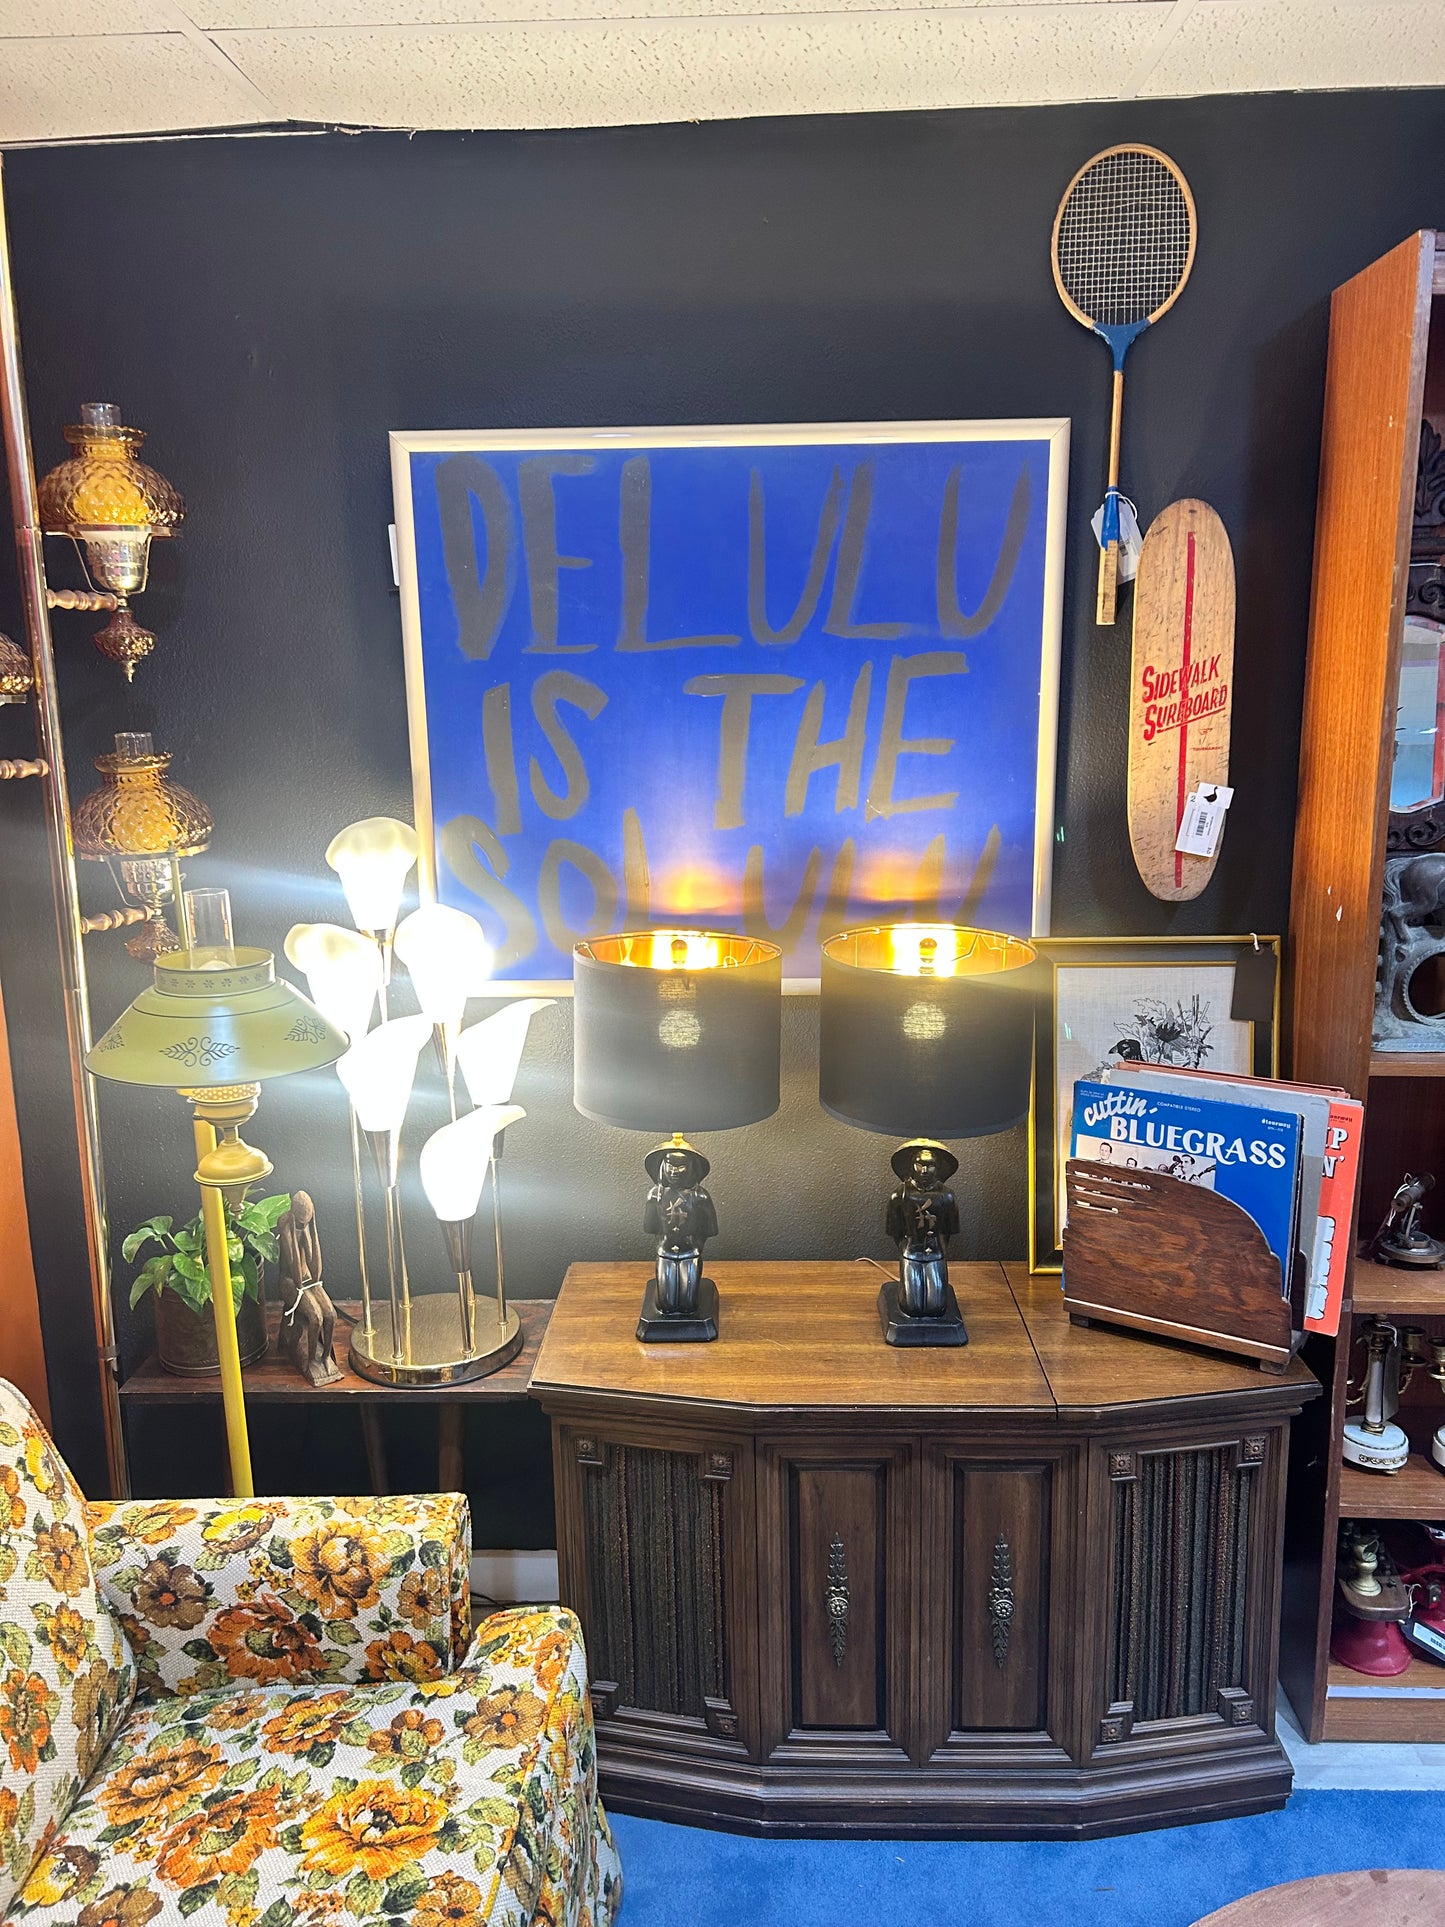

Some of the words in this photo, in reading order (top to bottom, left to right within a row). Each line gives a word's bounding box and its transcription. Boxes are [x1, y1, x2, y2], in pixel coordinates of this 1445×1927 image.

[1142, 653, 1222, 704] SIDEWALK
[1143, 685, 1228, 742] SURFBOARD
[482, 669, 609, 835] IS
[683, 651, 970, 830] THE
[1110, 1115, 1287, 1169] BLUEGRASS
